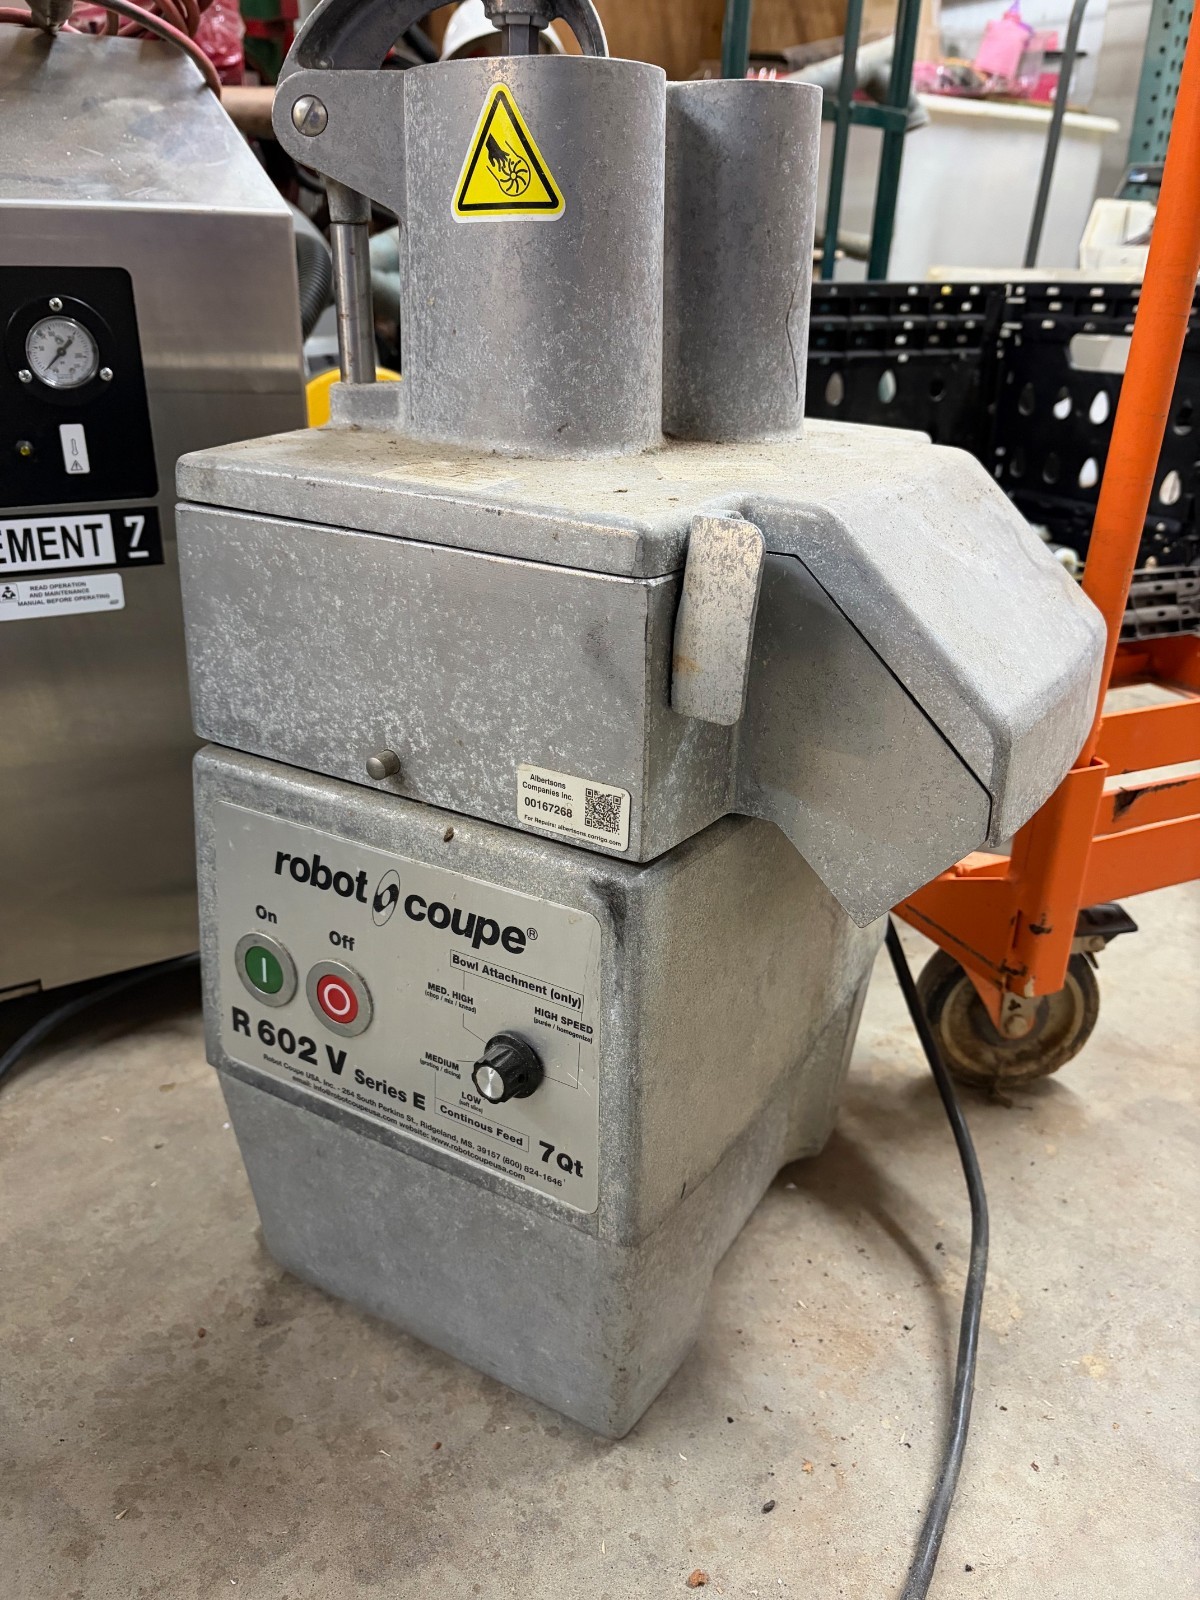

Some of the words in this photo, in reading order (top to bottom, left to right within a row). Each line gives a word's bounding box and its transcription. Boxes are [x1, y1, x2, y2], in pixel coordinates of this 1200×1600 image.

[44, 588, 90, 597] MAINTENANCE
[49, 581, 87, 589] OPERATION
[18, 599, 45, 607] MANUAL
[73, 593, 110, 601] OPERATING
[522, 781, 560, 797] Companies
[561, 792, 574, 801] Inc.
[530, 774, 566, 789] Albertsons
[524, 797, 573, 818] 00167268
[534, 817, 557, 828] Repairs:
[557, 825, 622, 847] albertsons.corrigo.com
[274, 851, 368, 903] robot
[255, 905, 278, 924] On
[329, 931, 355, 951] Off
[452, 954, 479, 972] Bowl
[482, 964, 548, 995] Attachment
[550, 988, 582, 1009] (only)
[427, 982, 450, 997] MED.
[452, 991, 474, 1005] HIGH
[534, 1006, 558, 1021] HIGH
[561, 1016, 593, 1034] SPEED
[231, 1006, 252, 1037] R
[257, 1020, 318, 1066] 602
[325, 1044, 347, 1076] V
[354, 1069, 407, 1103] Series
[413, 1091, 426, 1111] E
[425, 1051, 459, 1071] MEDIUM
[462, 1091, 481, 1105] LOW
[263, 1053, 282, 1066] Robot
[283, 1062, 304, 1076] Coupe
[356, 1093, 377, 1107] South
[378, 1102, 405, 1119] Perkins
[420, 1120, 459, 1143] Ridgeland,
[460, 1137, 475, 1150] MS.
[477, 1145, 501, 1160] 39157
[502, 1155, 523, 1171] (800)
[439, 1105, 493, 1134] Continous
[496, 1128, 523, 1147] Feed
[398, 1121, 430, 1139] website:
[431, 1135, 526, 1181] www.robotcoupeusa.com
